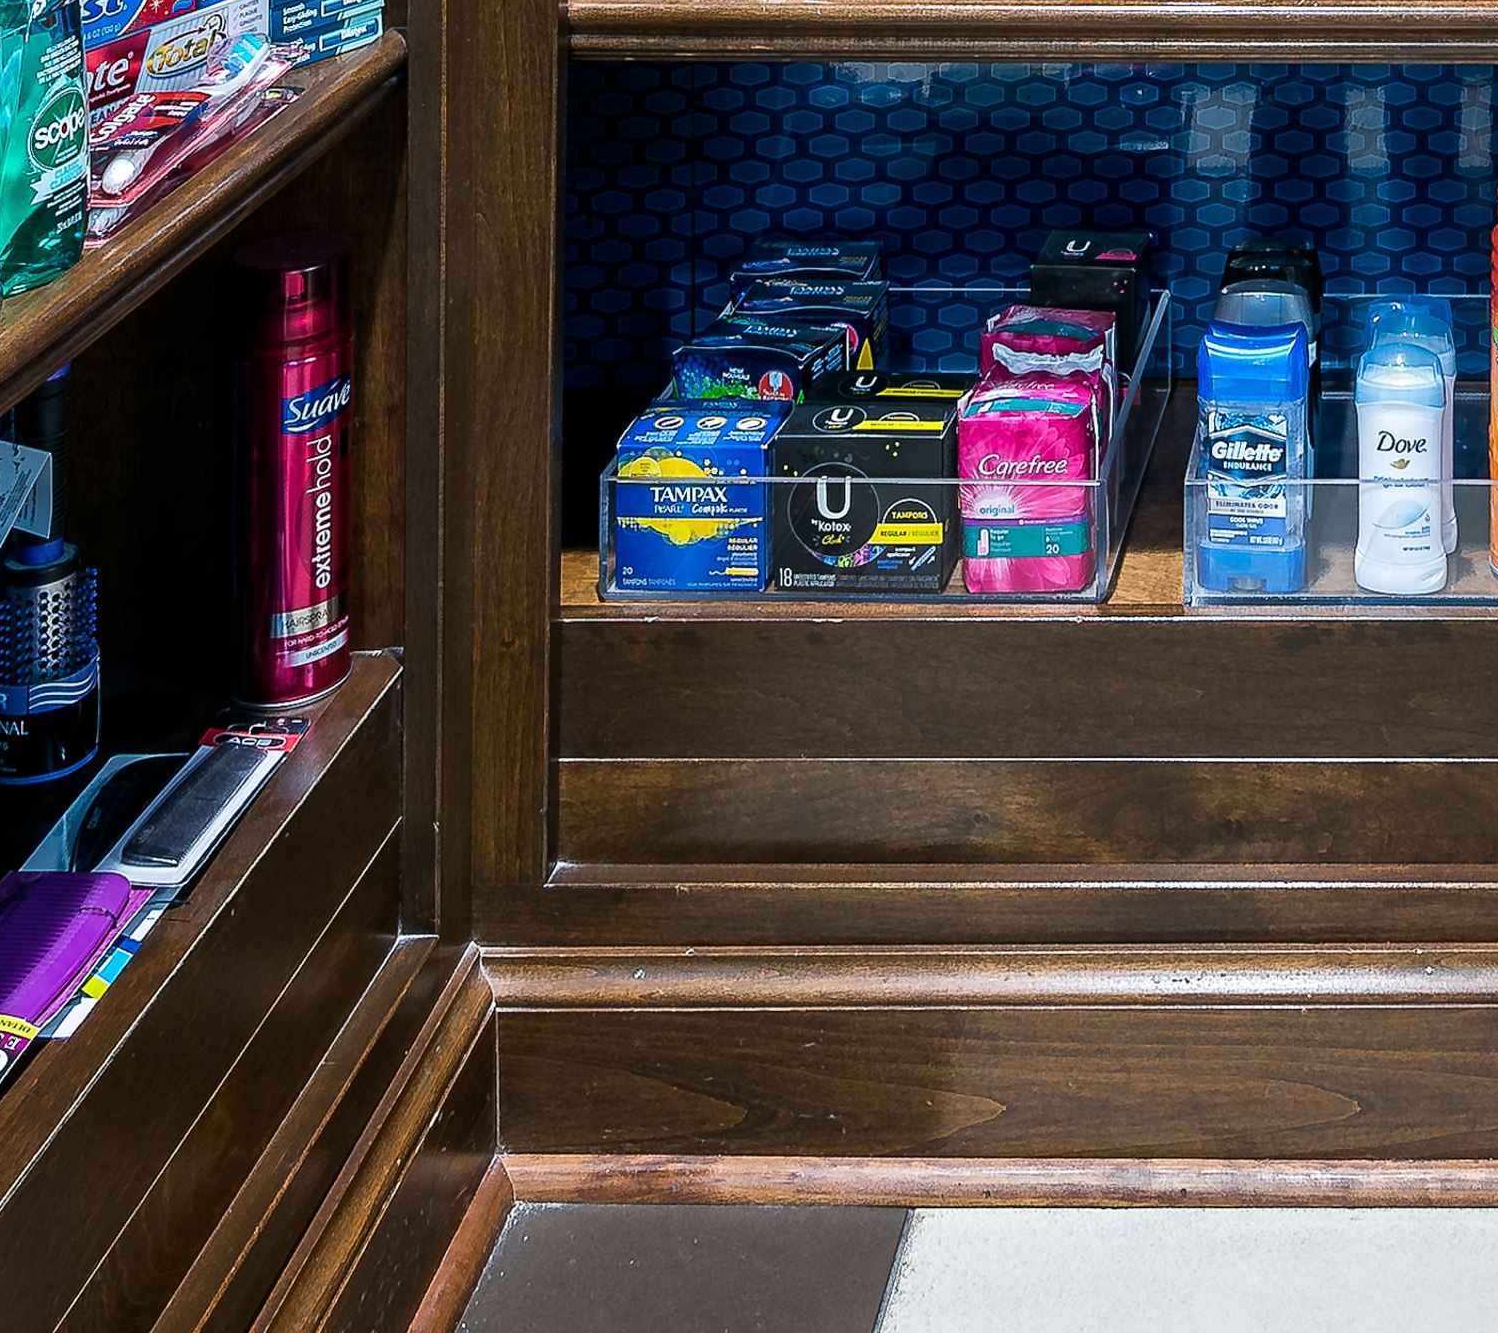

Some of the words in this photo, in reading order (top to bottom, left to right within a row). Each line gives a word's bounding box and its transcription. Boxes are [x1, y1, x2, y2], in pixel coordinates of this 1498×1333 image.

[156, 30, 226, 70] Total
[89, 93, 156, 143] Colgate
[34, 107, 85, 150] scope
[285, 378, 351, 424] Suave
[1212, 440, 1283, 462] Gillette
[1376, 431, 1427, 454] Dove
[978, 454, 1068, 475] Carefree
[1223, 460, 1272, 471] ENDURANCE
[650, 487, 727, 503] TAMPAX
[817, 476, 851, 519] U
[692, 503, 728, 516] Compak
[979, 504, 1015, 517] original
[1216, 501, 1256, 509] ELIMINATES
[891, 511, 928, 520] TAMPONS
[818, 520, 851, 532] Kotex
[1046, 543, 1060, 554] 20
[622, 566, 634, 575] 20
[779, 568, 792, 587] 18
